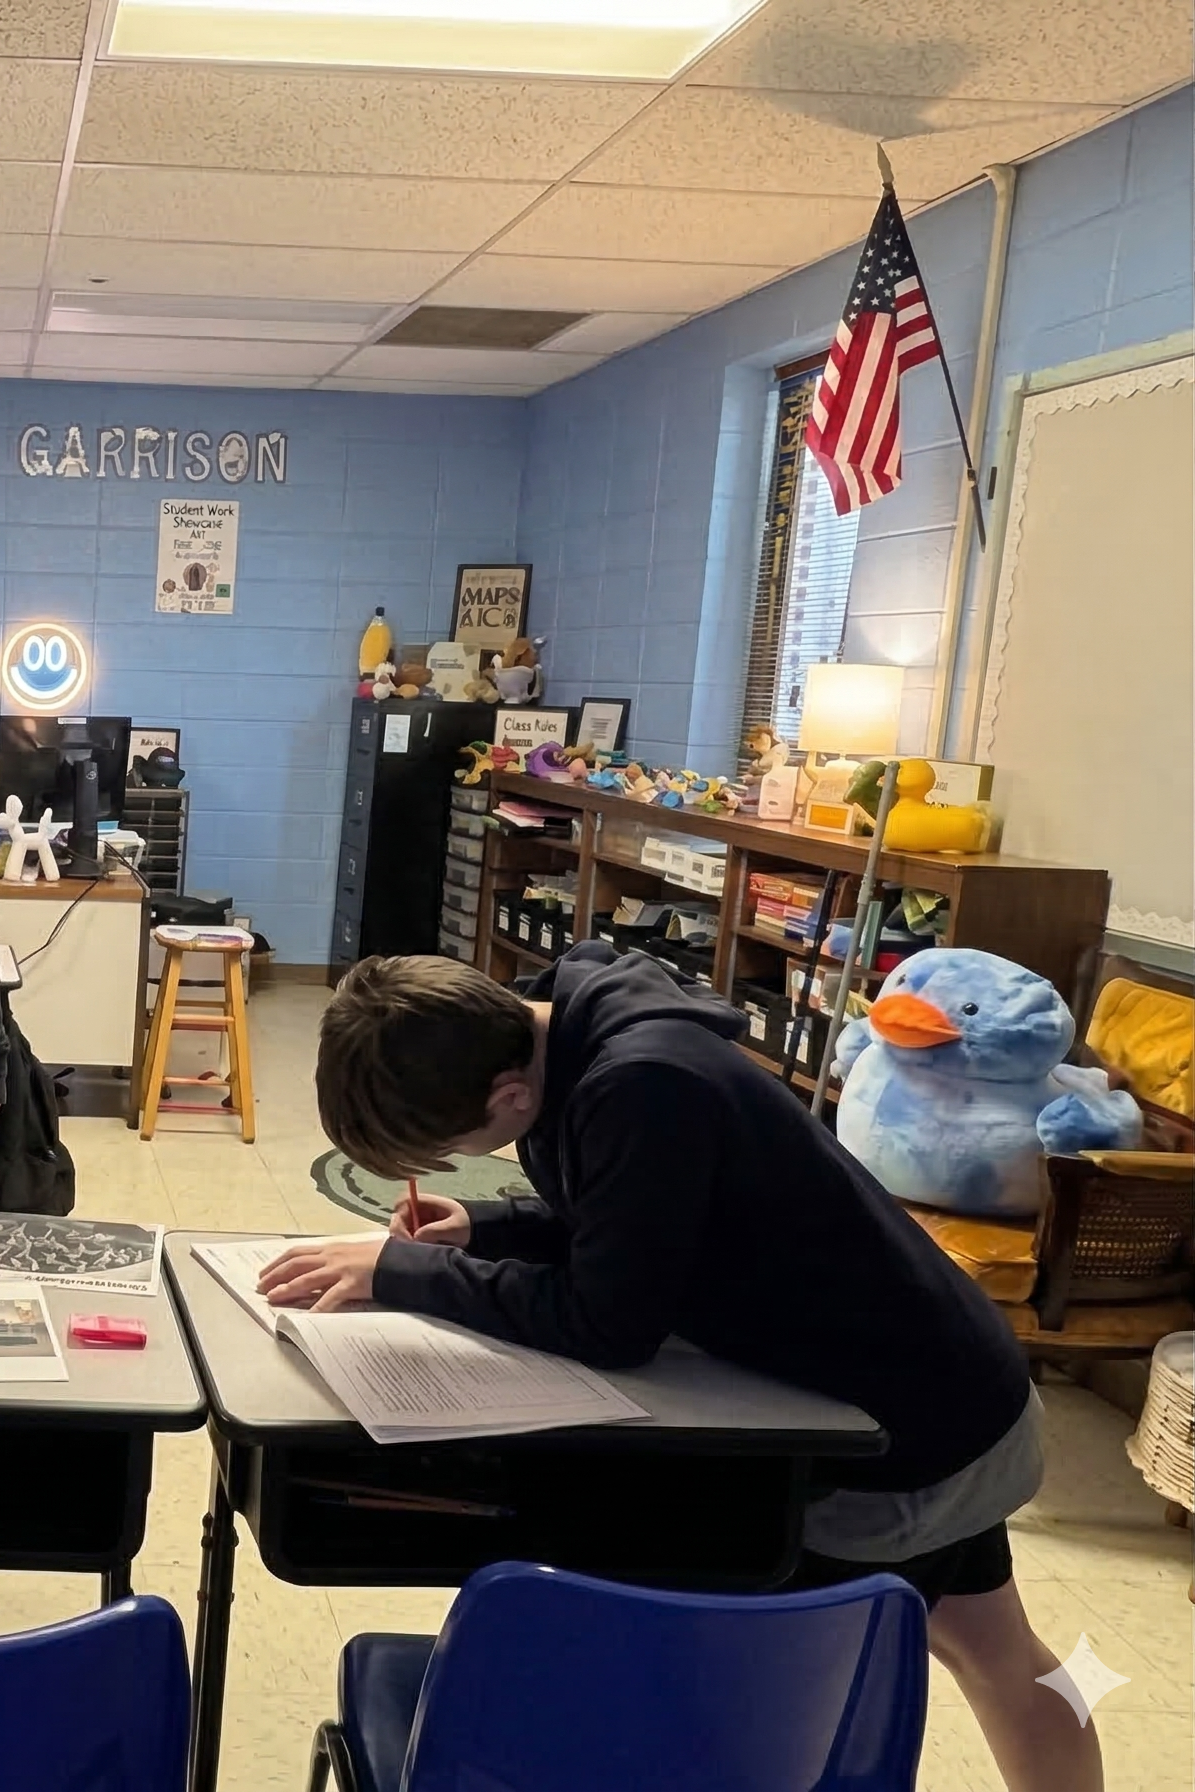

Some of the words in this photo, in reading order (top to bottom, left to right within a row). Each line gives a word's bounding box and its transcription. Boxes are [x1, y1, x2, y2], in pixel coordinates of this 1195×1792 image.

[17, 422, 289, 485] GARRISON
[207, 503, 235, 517] Work
[461, 586, 521, 606] MAPS
